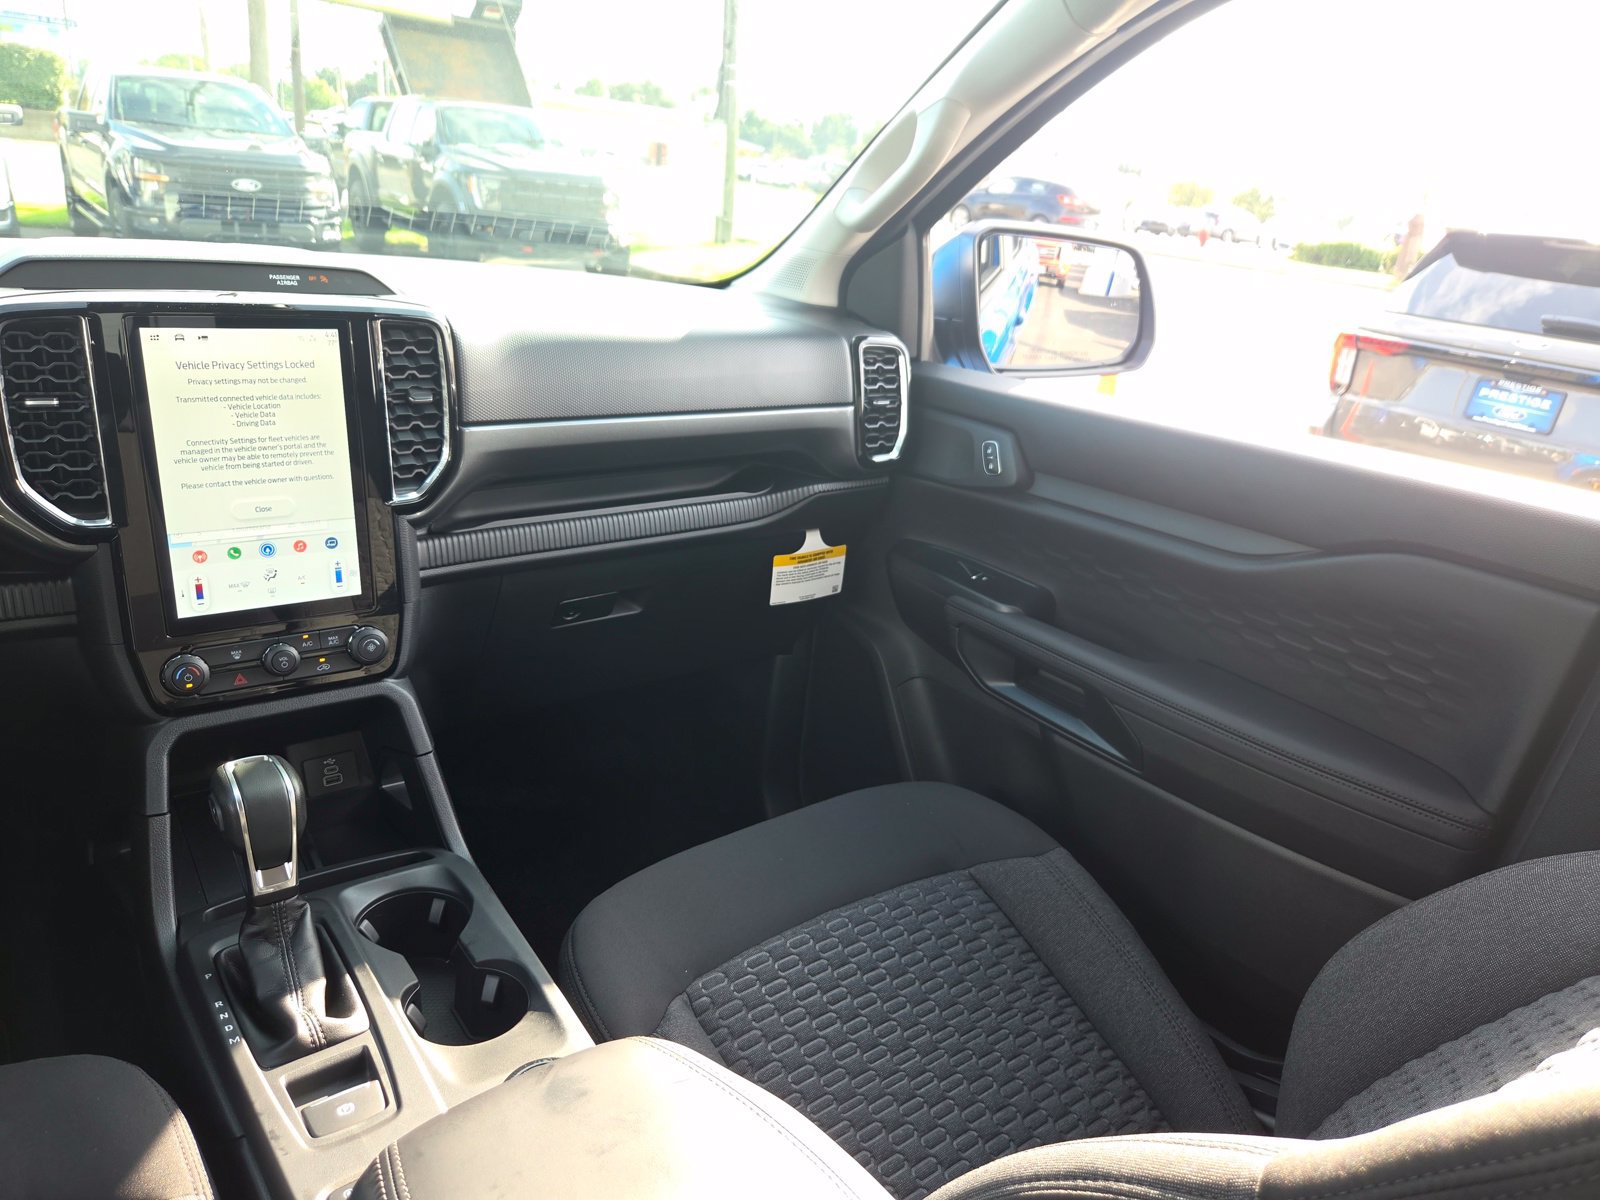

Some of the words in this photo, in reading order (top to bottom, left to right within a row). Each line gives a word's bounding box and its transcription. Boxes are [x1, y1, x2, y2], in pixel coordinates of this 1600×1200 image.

[176, 361, 210, 370] Vehicle
[212, 361, 245, 370] Privacy
[247, 360, 283, 370] Settings
[285, 360, 315, 369] Locked
[1478, 387, 1552, 410] PRESTIGE
[186, 438, 228, 447] Connectivity
[180, 448, 213, 456] managed
[254, 505, 272, 513] Close
[229, 1036, 240, 1045] M
